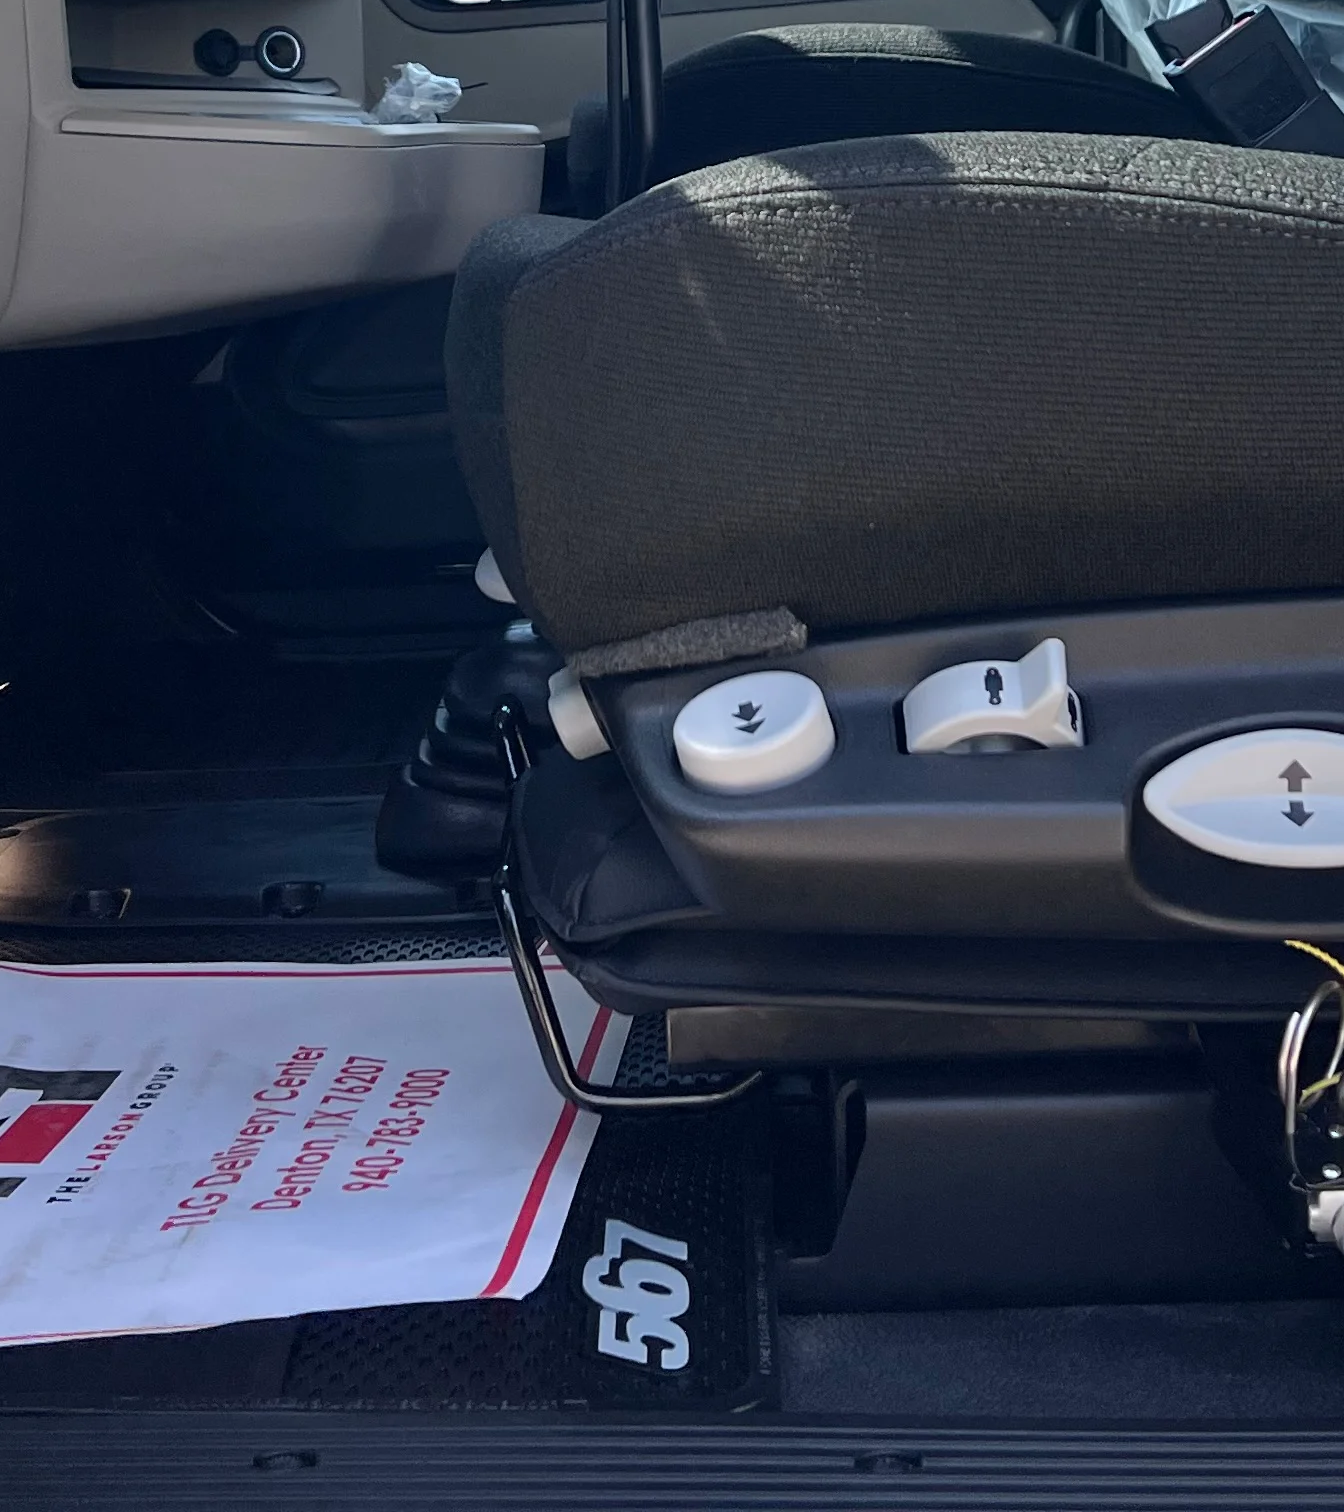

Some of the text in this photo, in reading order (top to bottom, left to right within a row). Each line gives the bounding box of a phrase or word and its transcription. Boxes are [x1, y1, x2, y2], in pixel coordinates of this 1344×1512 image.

[46, 1066, 179, 1204] THE LARSON GROUP
[160, 1045, 328, 1231] TLG Delivery Center
[250, 1055, 388, 1211] Denton, TX 76207
[341, 1068, 451, 1192] 940-783-9000
[582, 1218, 690, 1370] 567
